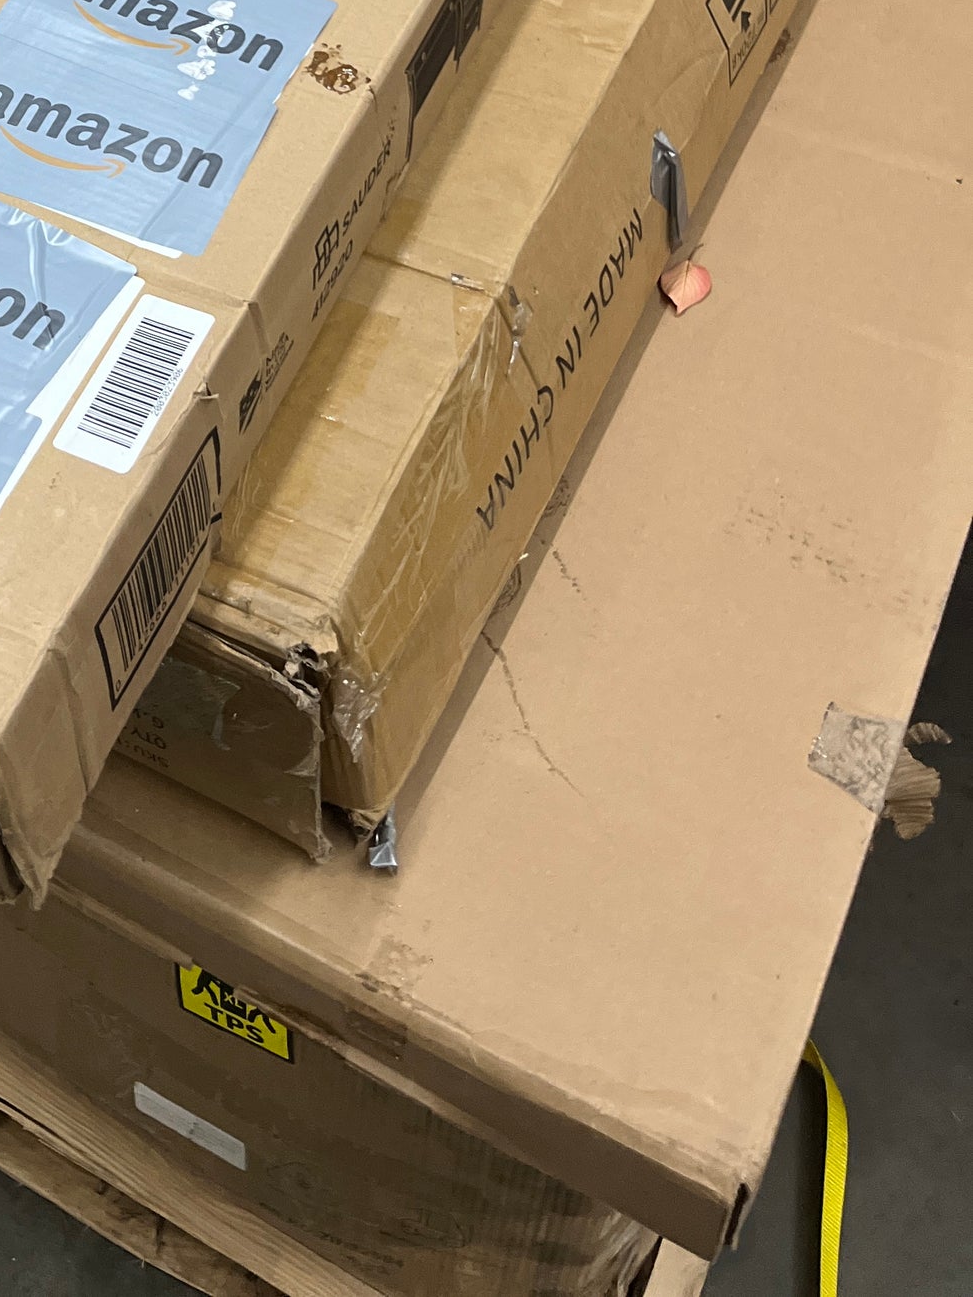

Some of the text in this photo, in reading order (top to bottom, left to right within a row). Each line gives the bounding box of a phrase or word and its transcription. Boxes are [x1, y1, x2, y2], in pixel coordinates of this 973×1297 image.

[476, 207, 645, 531] MADE IN CHINA
[204, 1002, 265, 1044] TPS
